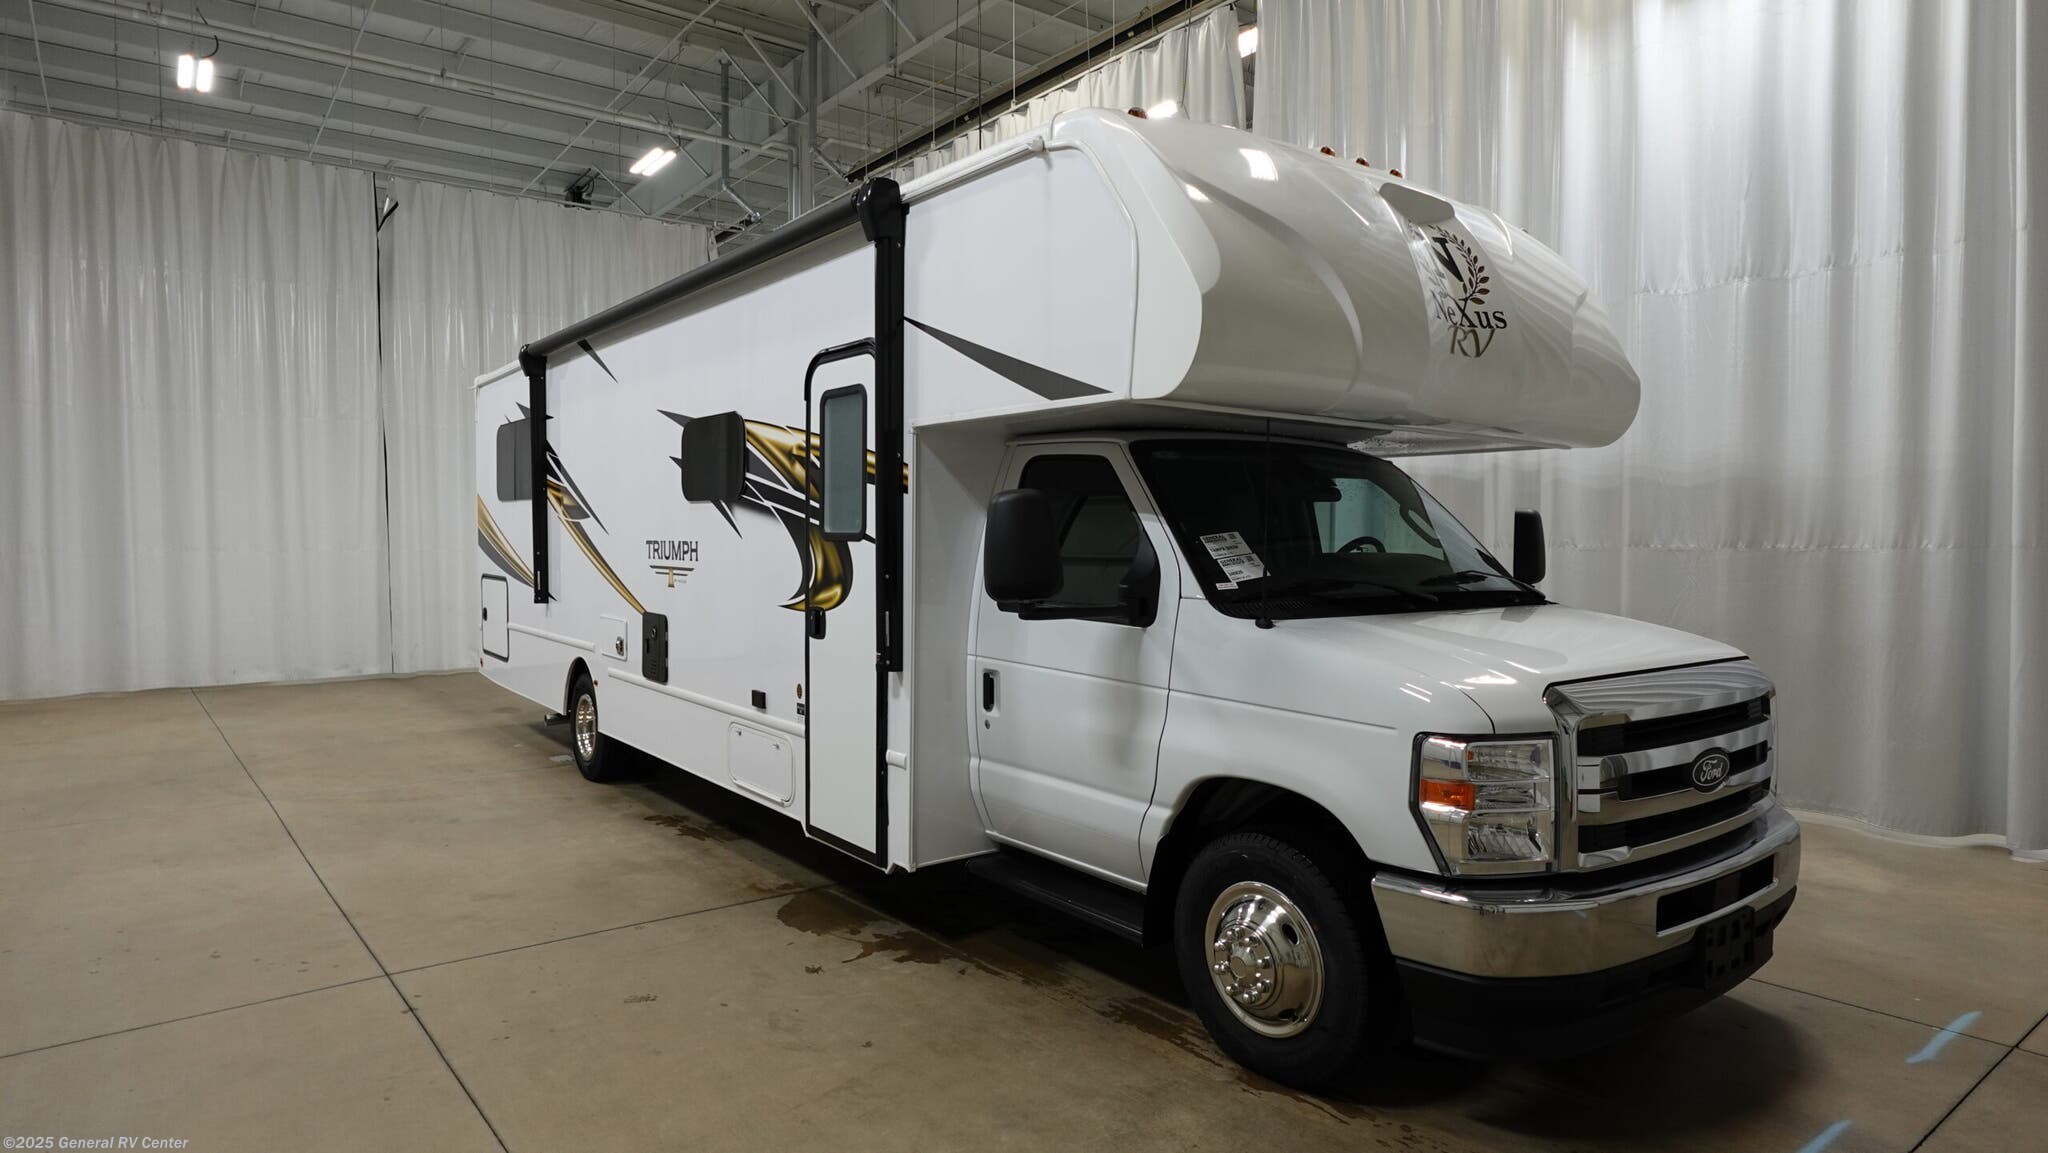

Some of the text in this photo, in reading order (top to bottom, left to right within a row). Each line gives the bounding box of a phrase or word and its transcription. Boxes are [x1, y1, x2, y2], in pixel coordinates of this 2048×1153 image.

[1448, 325, 1496, 358] RV
[645, 539, 699, 562] TRIUMPH
[1700, 759, 1723, 782] Ford
